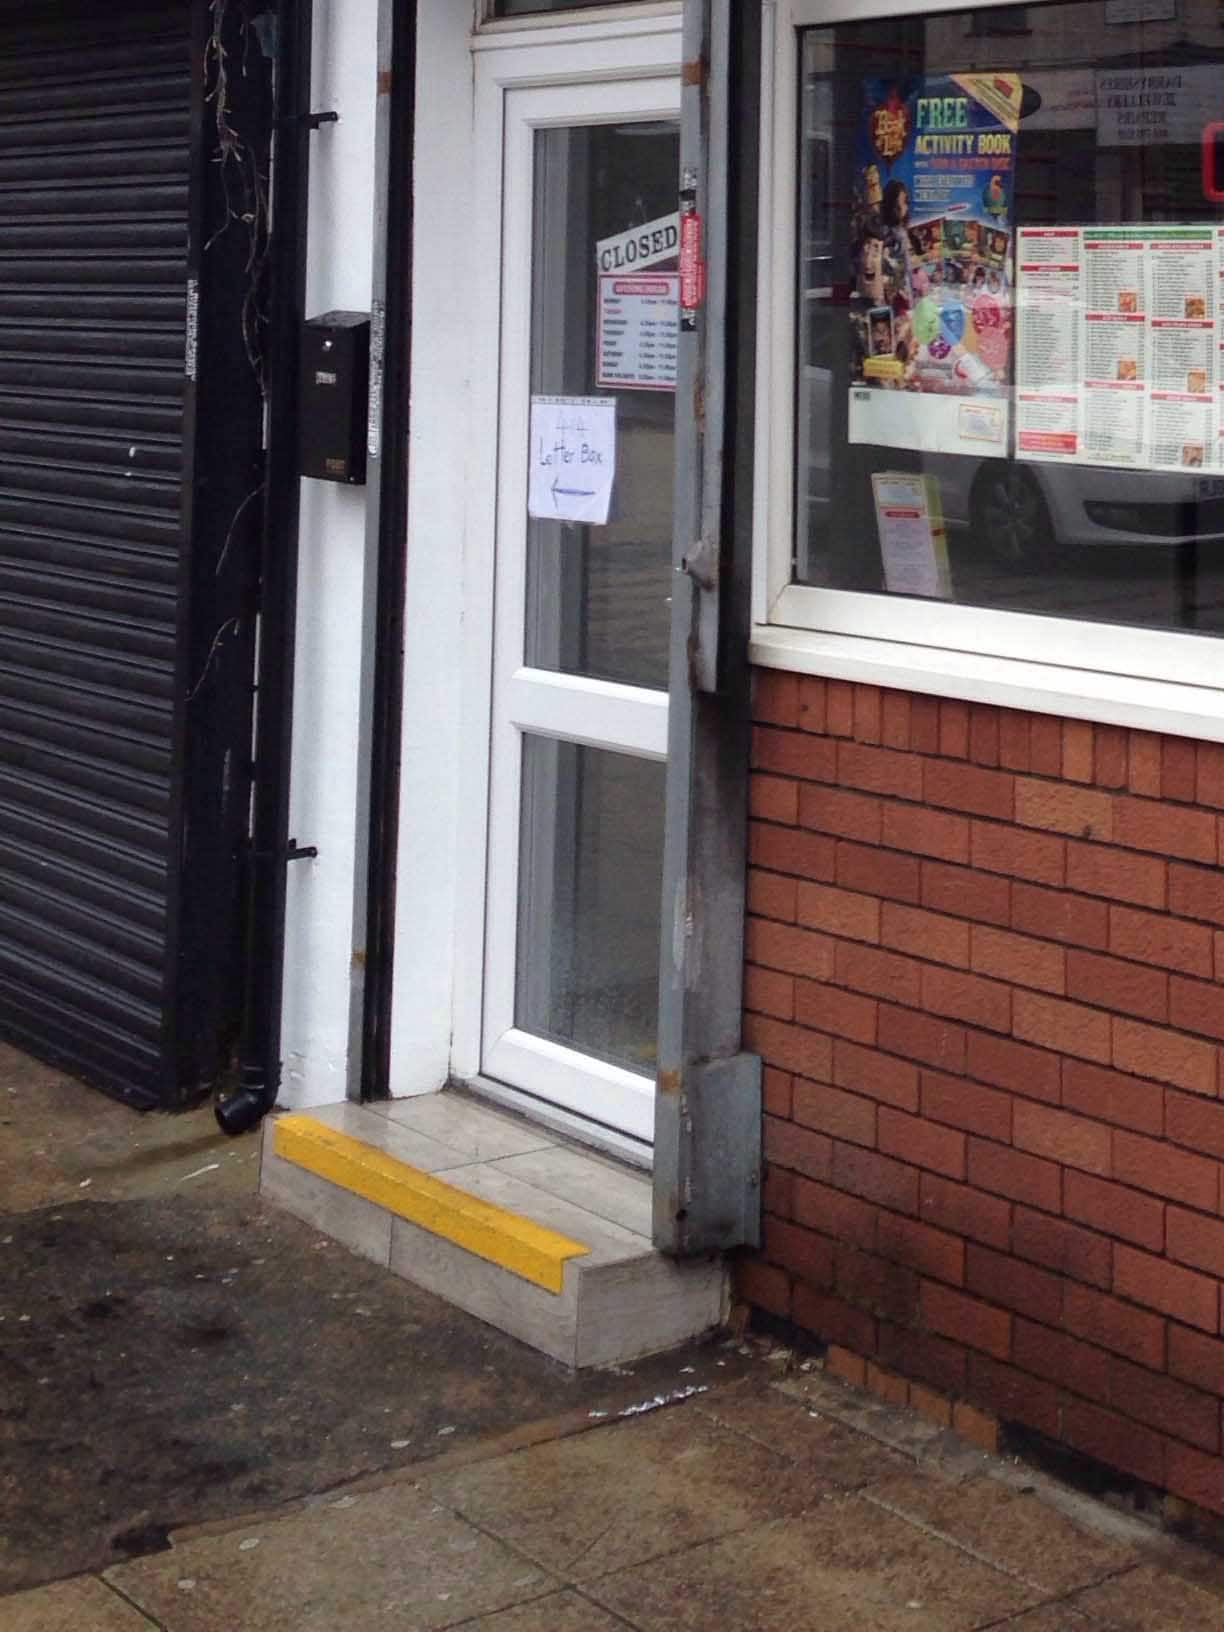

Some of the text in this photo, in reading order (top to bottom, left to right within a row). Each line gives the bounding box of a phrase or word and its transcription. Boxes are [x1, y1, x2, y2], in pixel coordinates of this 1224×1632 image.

[916, 98, 968, 129] FREE
[914, 134, 1012, 155] ACTIVITY BOOK
[601, 225, 678, 272] CLOSED
[540, 435, 603, 466] Letter Box
